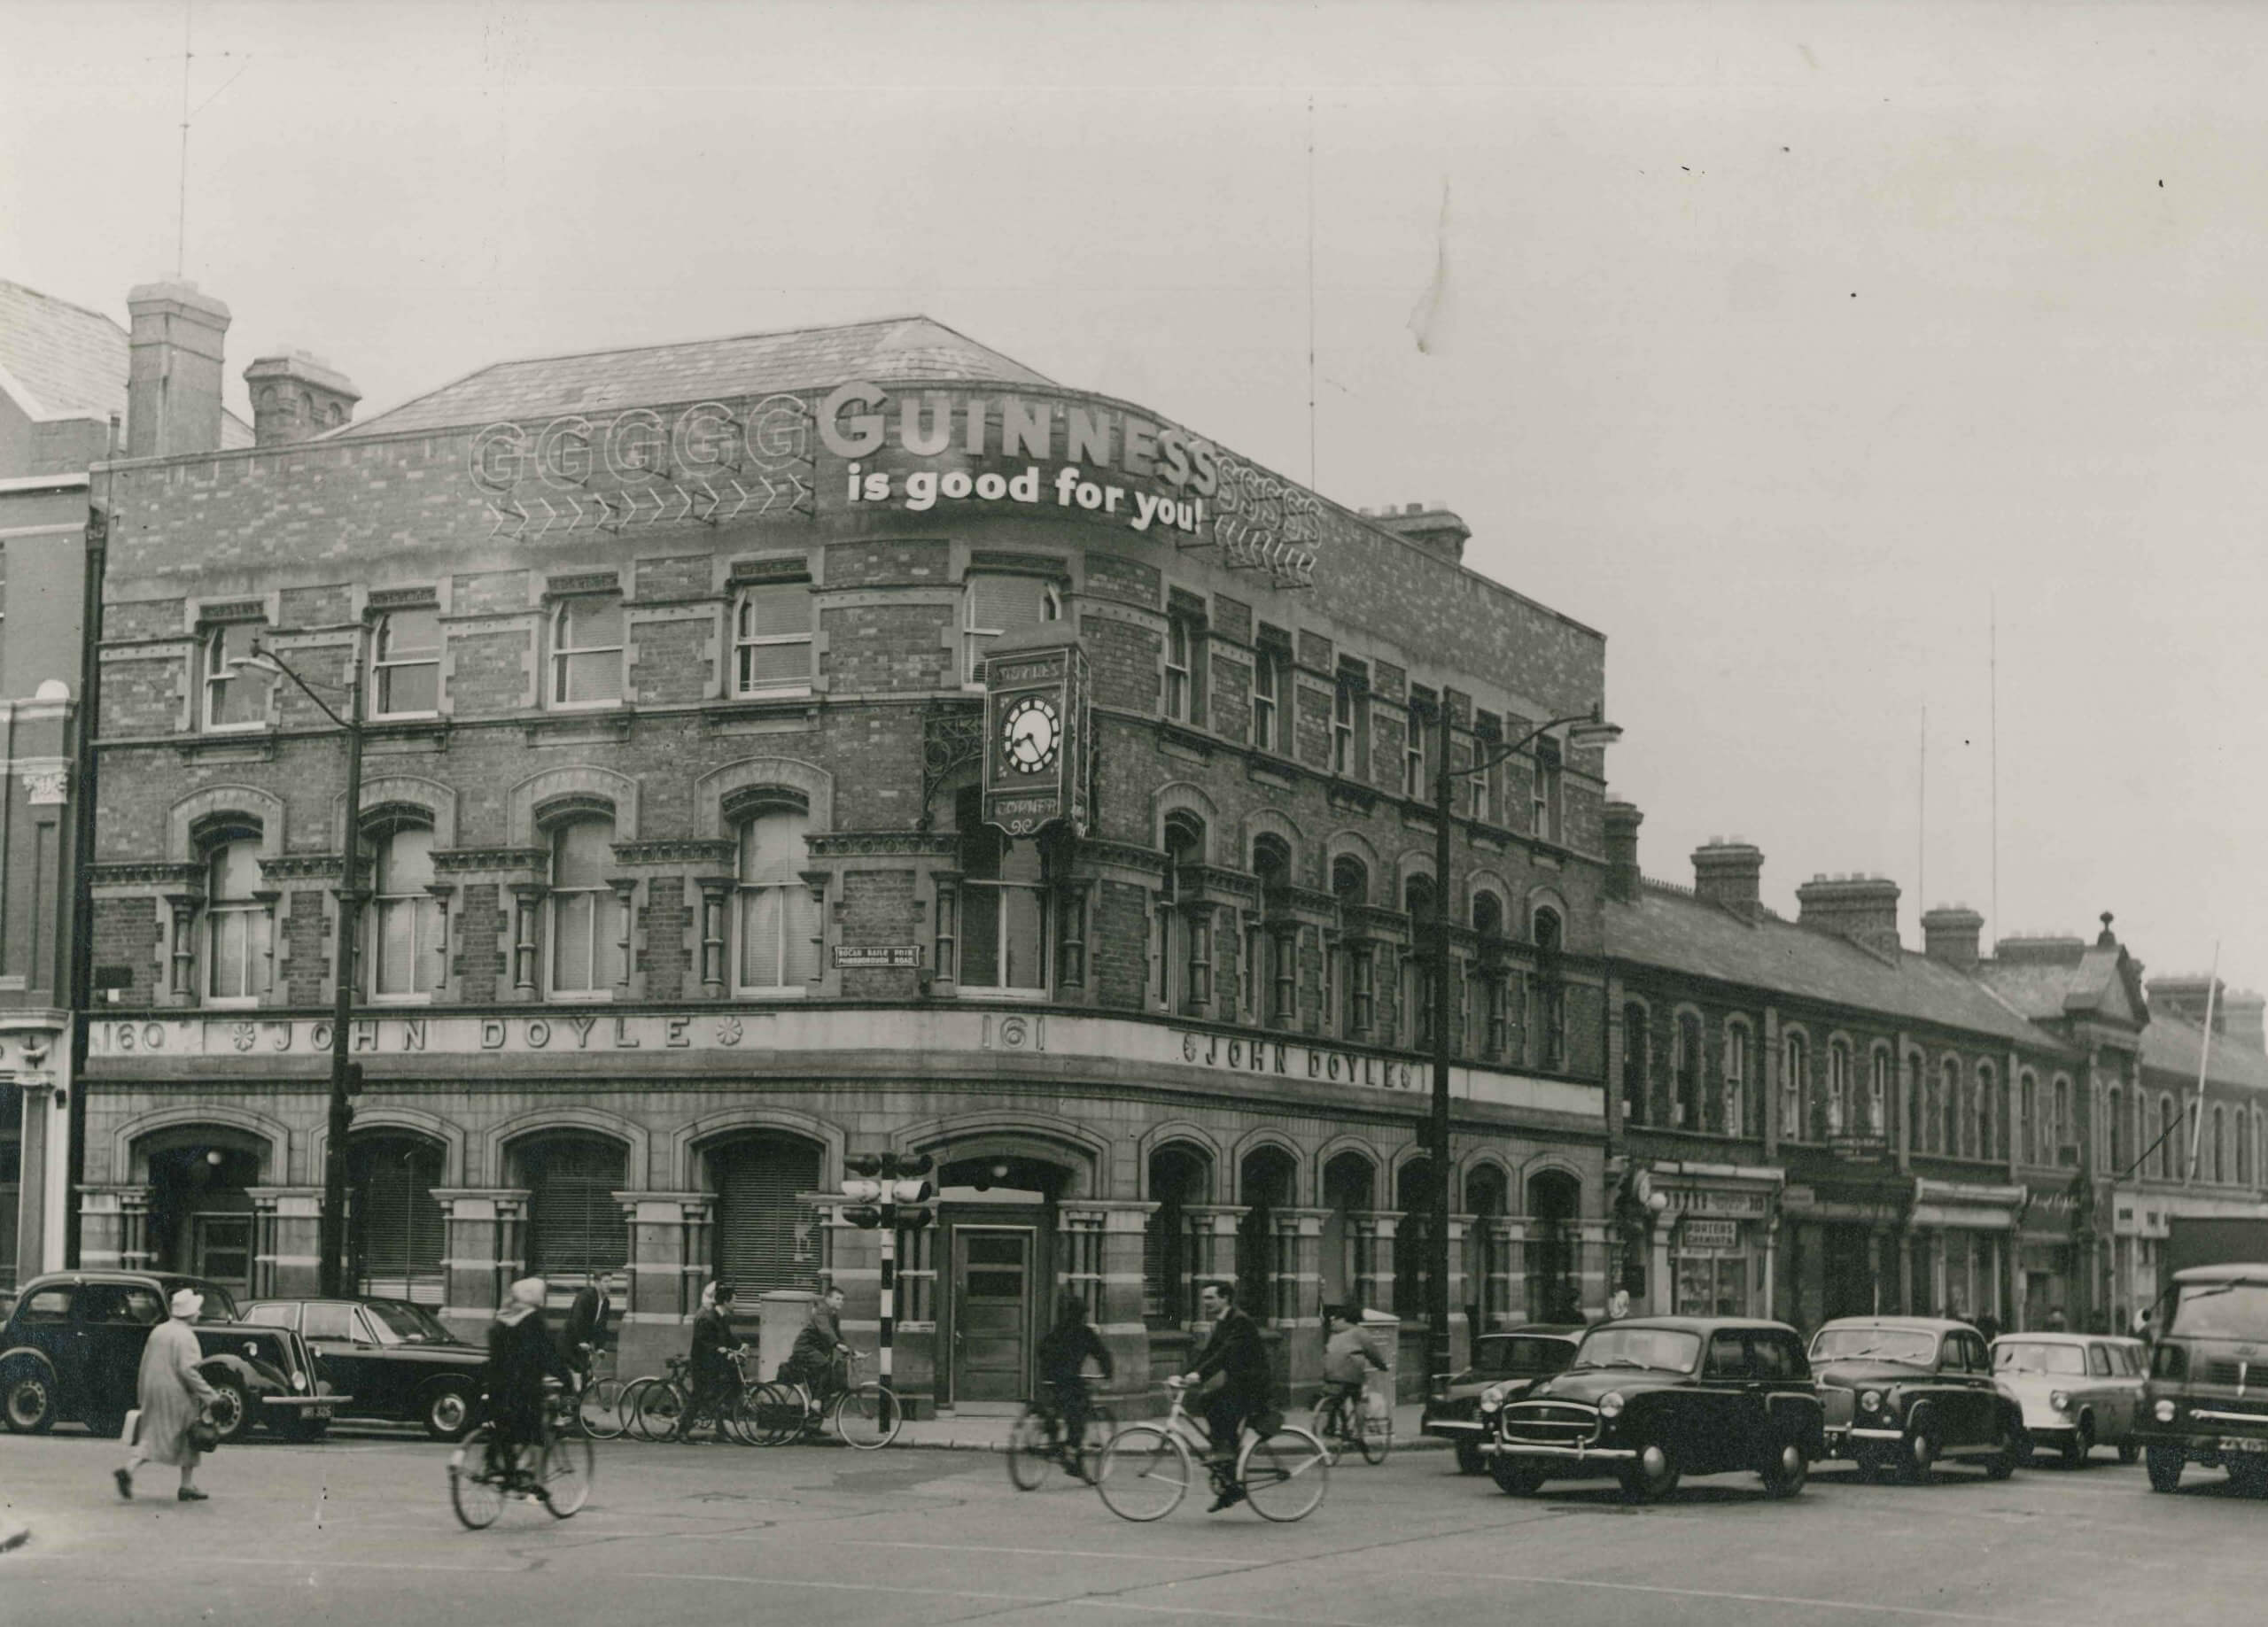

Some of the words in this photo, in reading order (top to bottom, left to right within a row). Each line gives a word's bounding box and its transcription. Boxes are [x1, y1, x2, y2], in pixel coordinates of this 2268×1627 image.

[818, 380, 1218, 497] GUINNESS
[848, 462, 891, 502] is
[905, 467, 1039, 511] good
[1055, 468, 1123, 513] for
[1130, 490, 1202, 534] you!
[102, 1022, 167, 1052] 160
[274, 1019, 427, 1052] JOHN
[481, 1017, 691, 1050] DOYLE
[1206, 1034, 1286, 1074] JOHN
[1309, 1048, 1395, 1089] DOYLE
